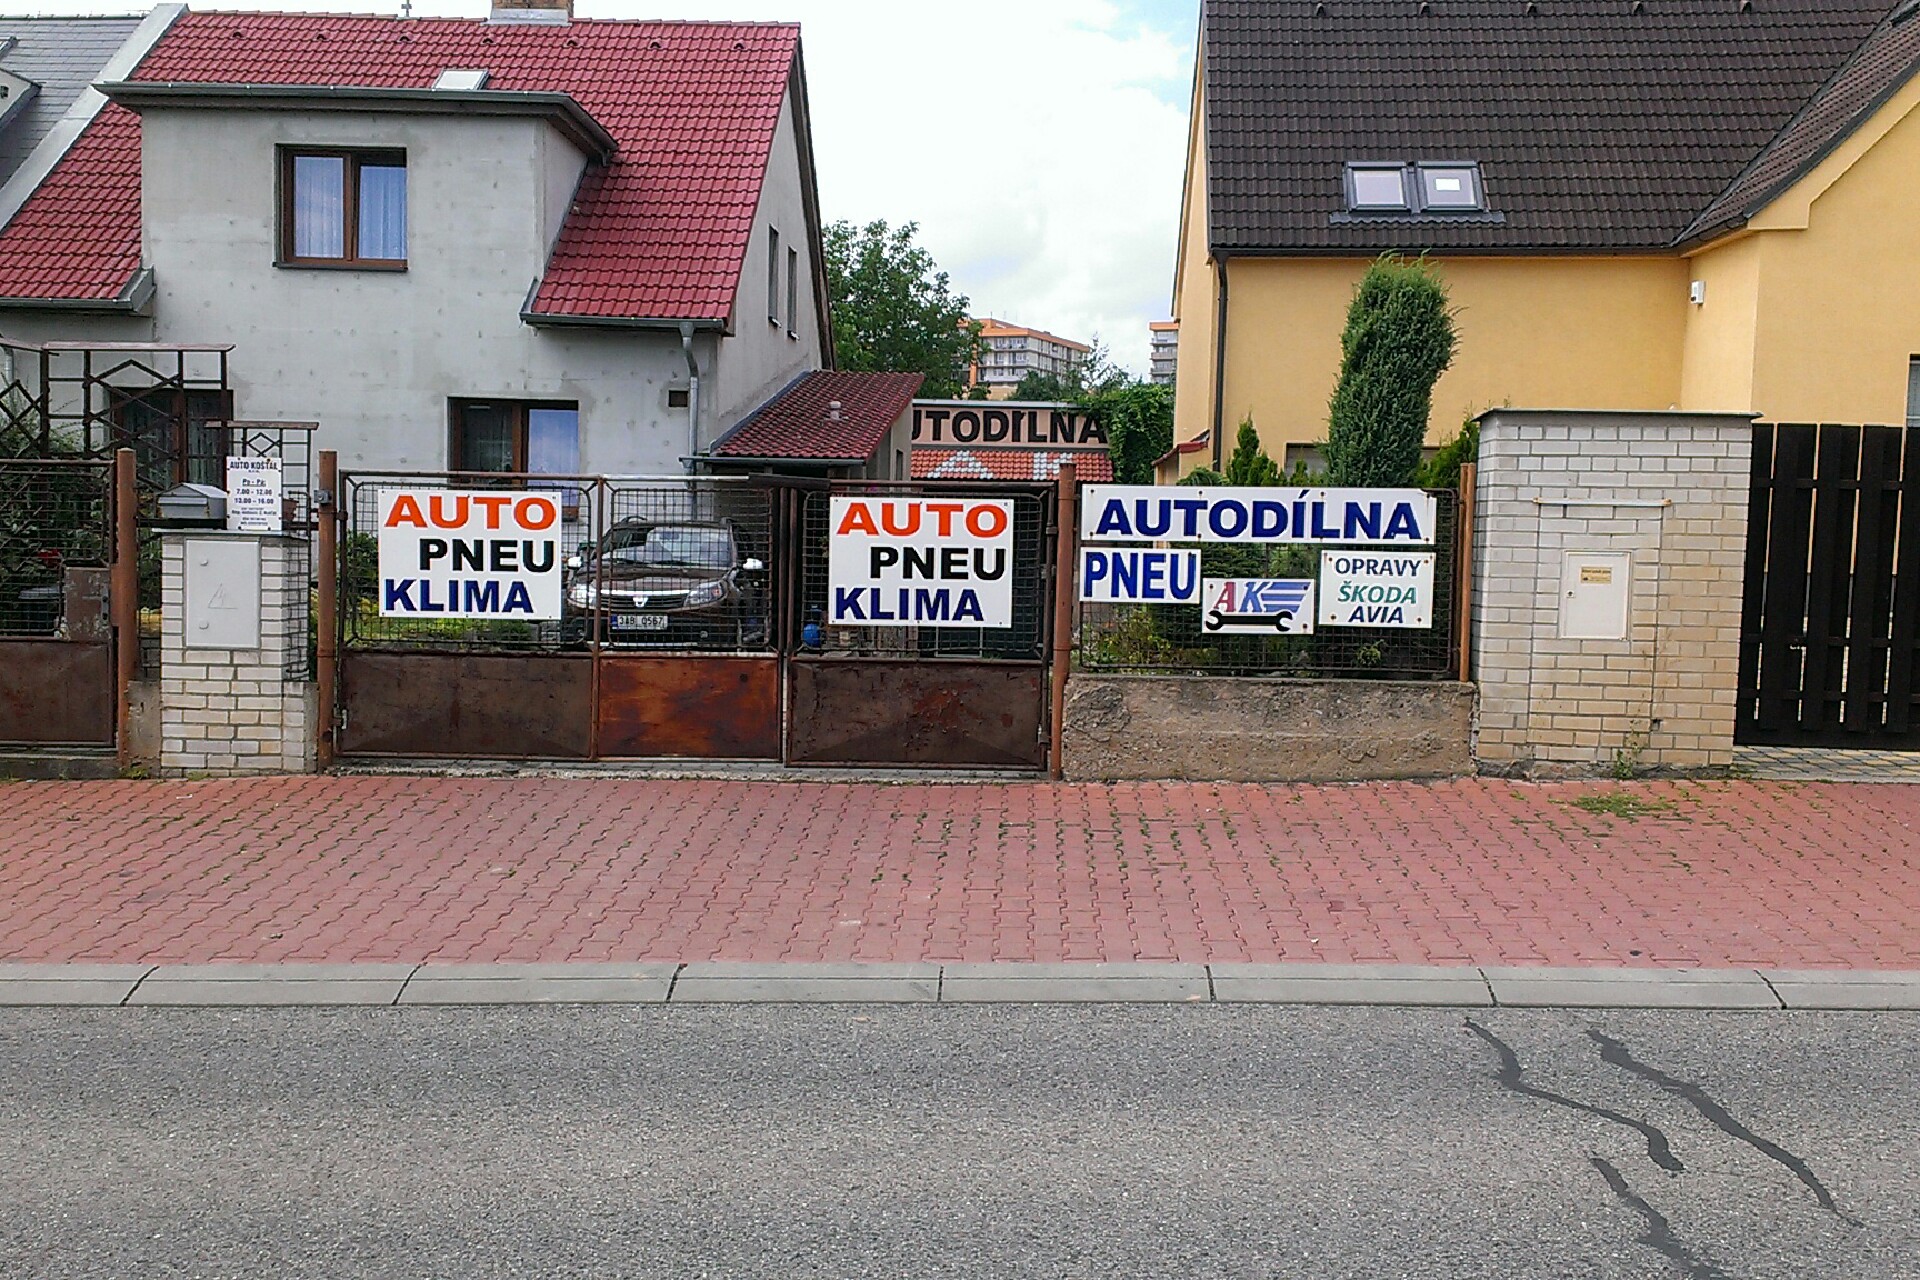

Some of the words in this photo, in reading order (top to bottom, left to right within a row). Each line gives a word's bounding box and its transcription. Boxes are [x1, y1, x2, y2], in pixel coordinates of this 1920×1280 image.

[230, 461, 249, 469] AUTO
[384, 494, 557, 531] AUTO
[836, 502, 1008, 538] AUTO
[1096, 490, 1422, 540] AUTODÍLNA
[419, 538, 555, 573] PNEU
[870, 546, 1005, 580] PNEU
[1335, 557, 1422, 577] OPRAVY
[1084, 551, 1196, 600] PNEU
[385, 578, 534, 614] KLIMA
[835, 587, 985, 621] KLIMA
[1213, 581, 1269, 613] AK
[1337, 581, 1418, 605] ŠKODA
[1348, 606, 1404, 624] AVIA
